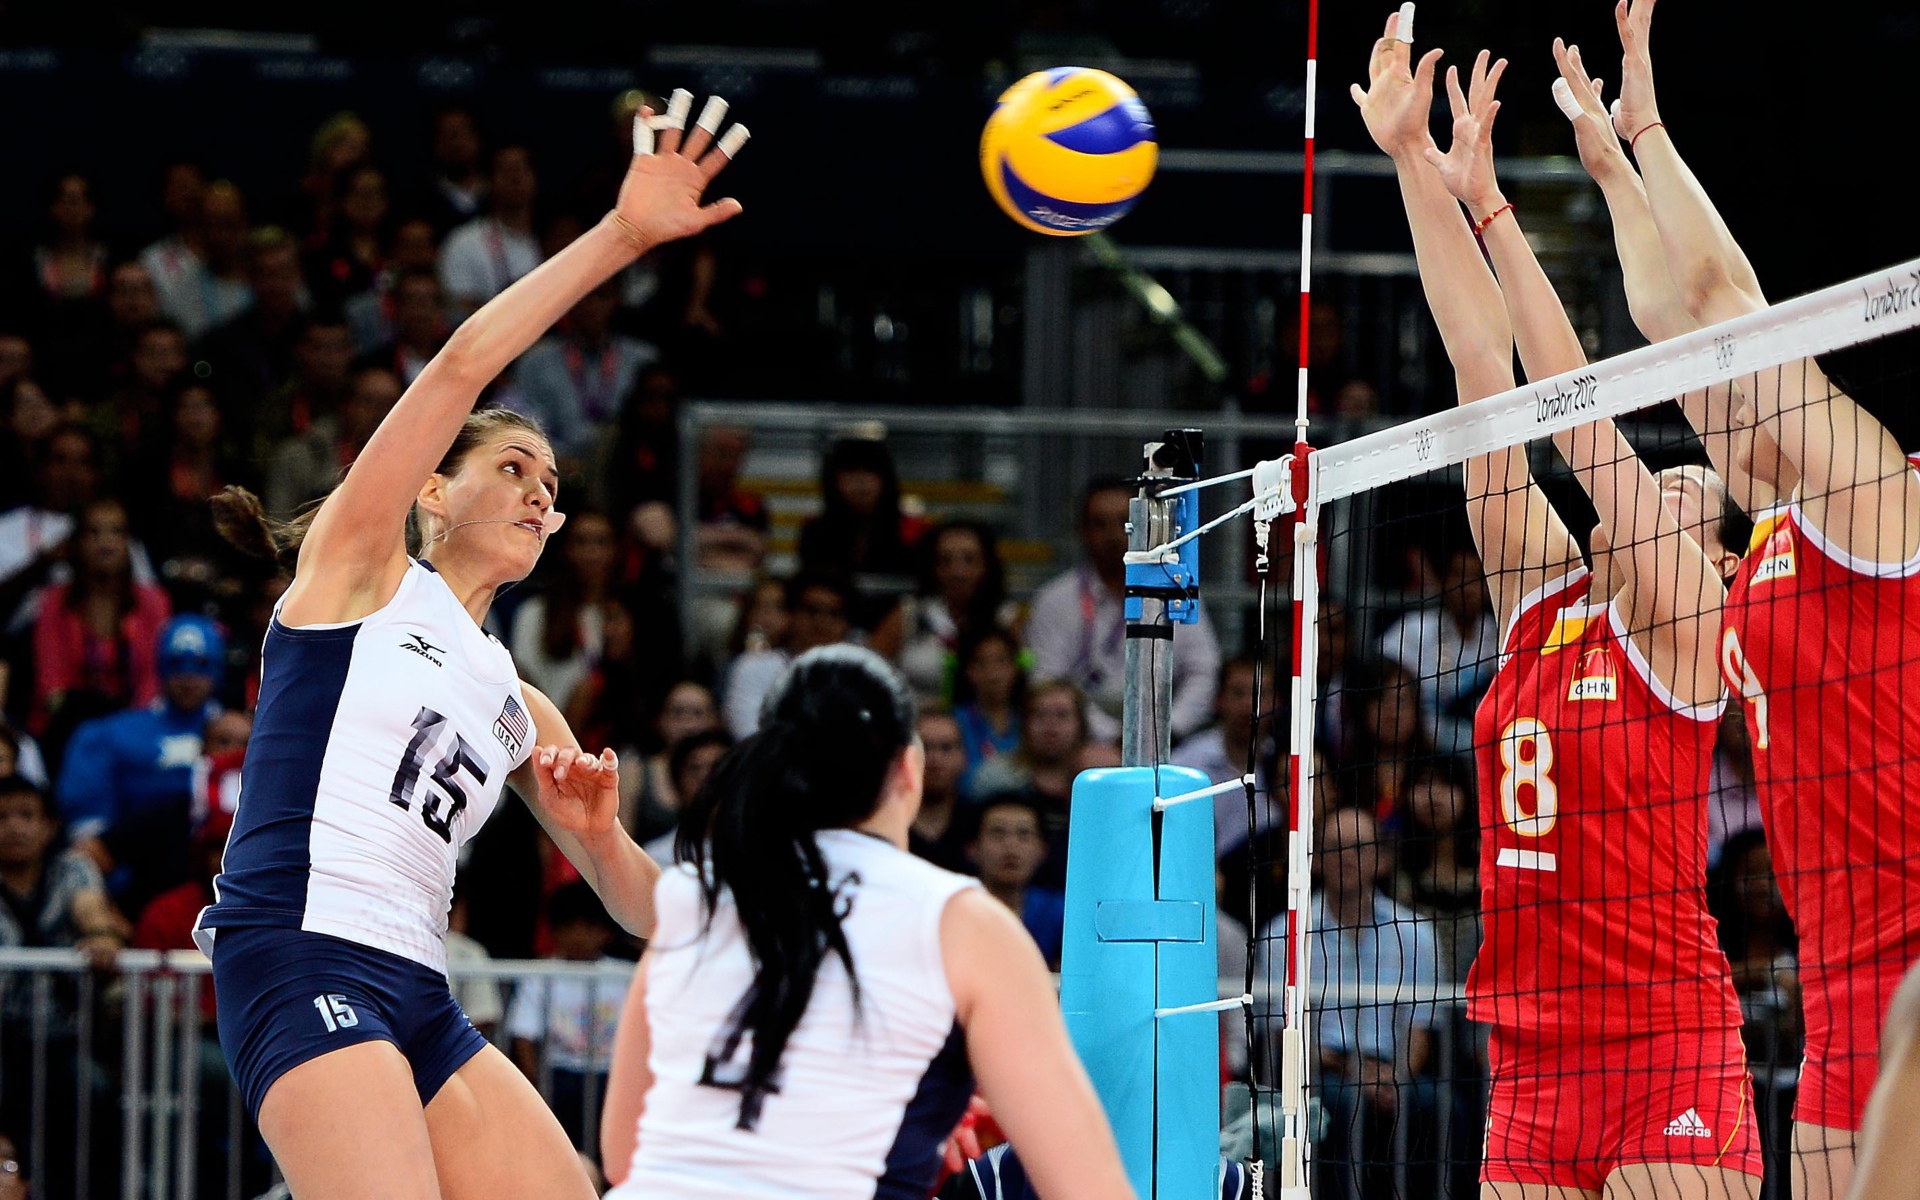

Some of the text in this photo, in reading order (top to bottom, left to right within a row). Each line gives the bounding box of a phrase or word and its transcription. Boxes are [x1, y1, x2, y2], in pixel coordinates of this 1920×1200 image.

[1863, 277, 1909, 322] London
[1535, 374, 1598, 422] London 2012
[1575, 682, 1610, 695] CHN
[1722, 626, 1767, 749] 9
[498, 726, 516, 757] USA
[389, 706, 490, 844] 15
[1500, 716, 1557, 837] 8
[313, 994, 359, 1033] 15
[1663, 1124, 1711, 1138] adidas
